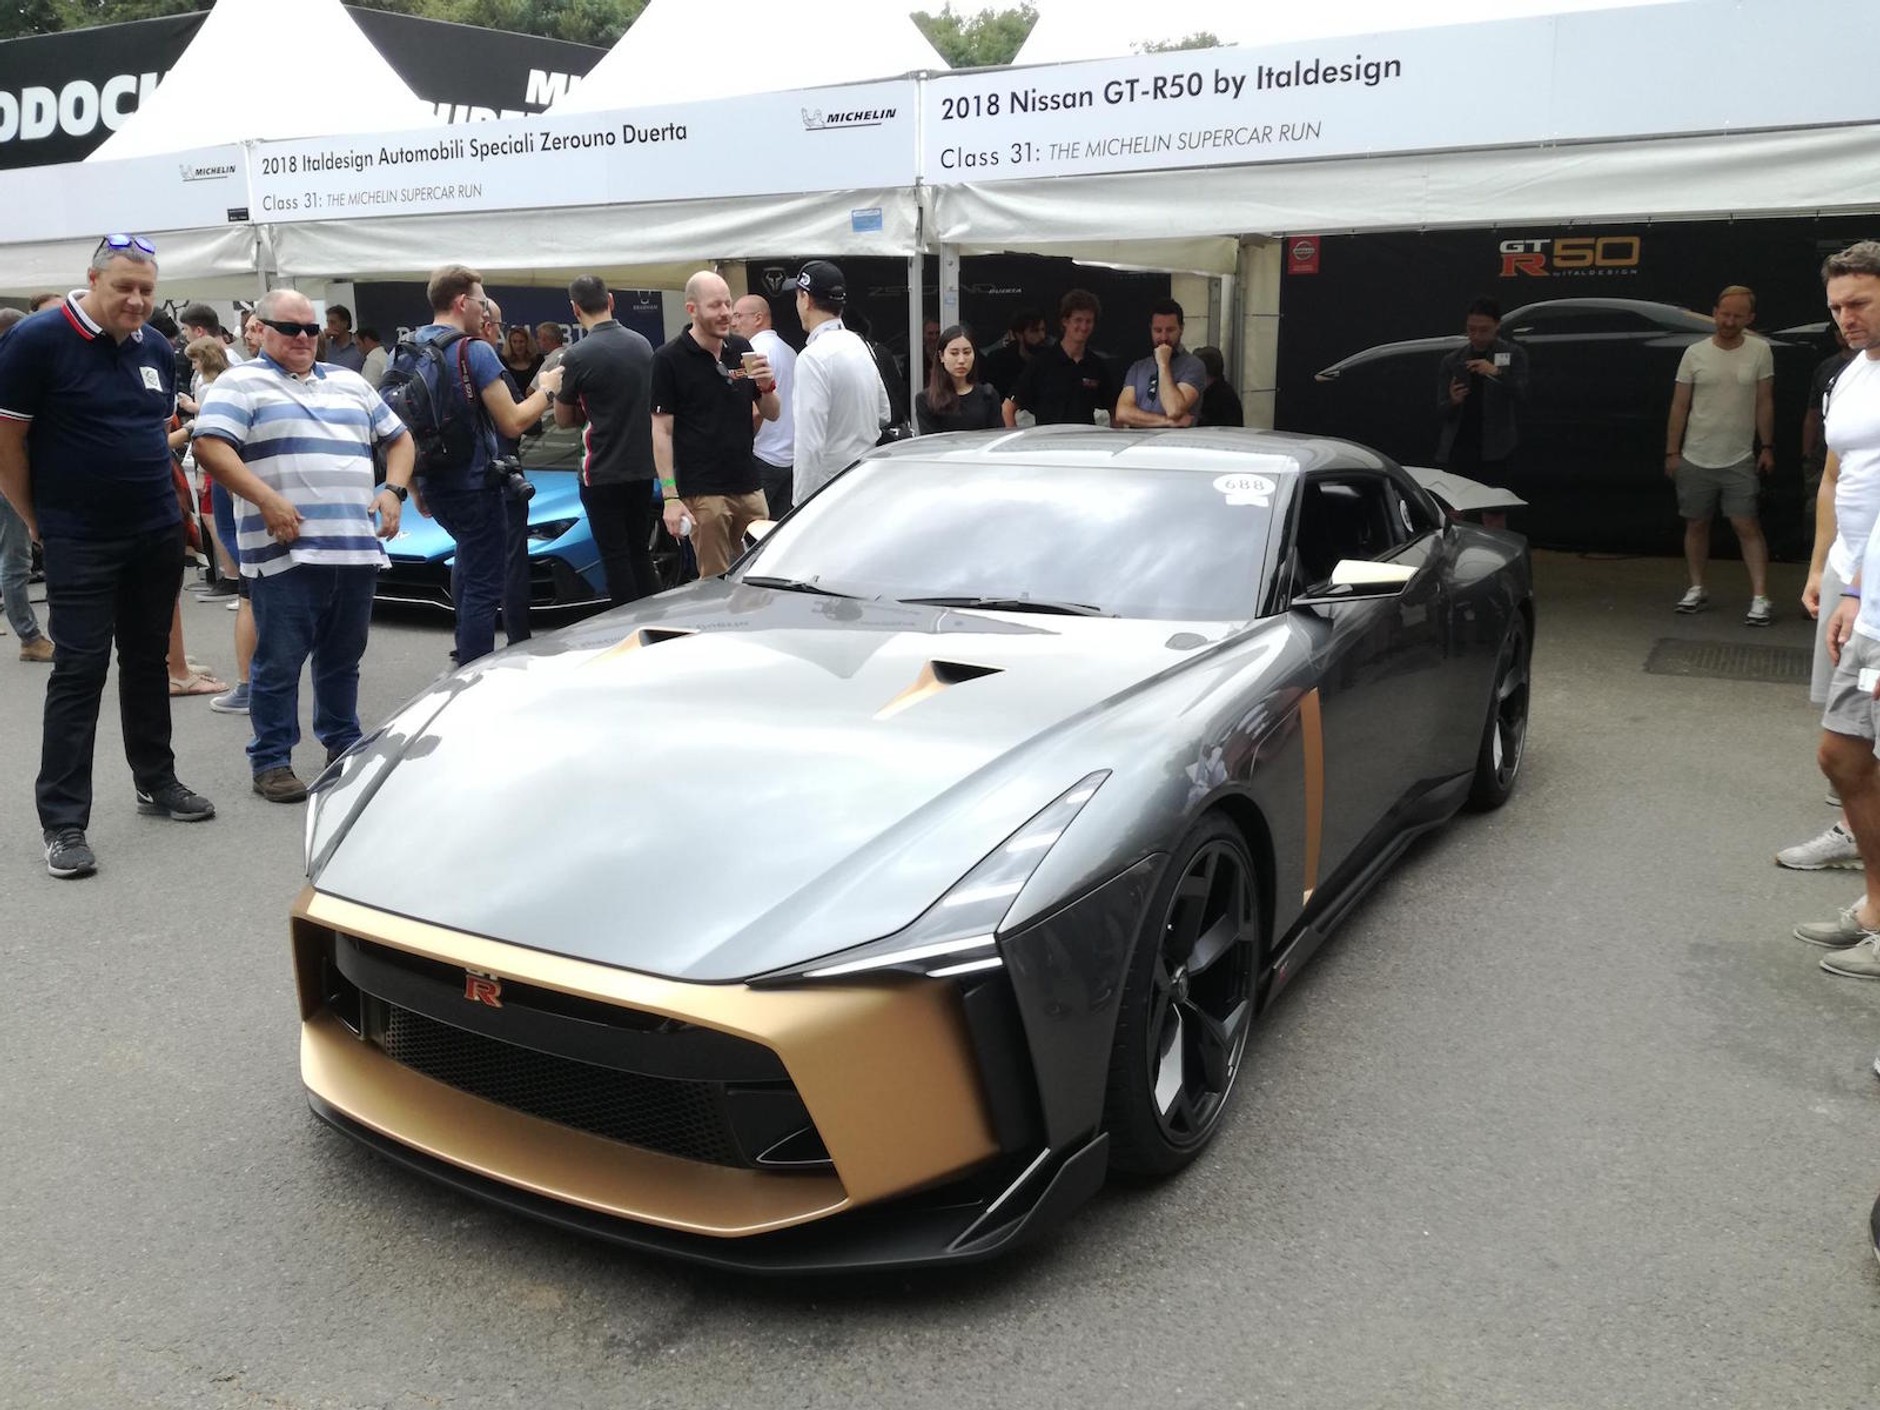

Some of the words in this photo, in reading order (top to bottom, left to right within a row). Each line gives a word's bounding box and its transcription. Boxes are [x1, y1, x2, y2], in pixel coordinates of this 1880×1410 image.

[941, 93, 1000, 121] 2018
[1010, 88, 1093, 114] Nissan
[1103, 72, 1203, 104] GT-R50
[1213, 69, 1246, 99] by
[1256, 54, 1402, 90] Italdesign
[826, 108, 897, 123] MICHELIN
[262, 155, 298, 175] 2018
[302, 150, 374, 172] Italdesign
[378, 139, 465, 166] Automobili
[469, 132, 534, 162] Speciali
[540, 130, 616, 151] Zerouno
[623, 122, 688, 145] Duerta
[941, 147, 999, 169] Class
[1010, 142, 1040, 163] 31:
[1049, 142, 1081, 160] THE
[1085, 134, 1171, 158] MICHELIN
[1177, 125, 1273, 150] SUPERCAR
[1278, 121, 1322, 142] RUN
[195, 165, 236, 176] MICHELIN
[262, 195, 298, 211] Class
[304, 192, 323, 209] 31:
[327, 193, 346, 207] THE
[348, 189, 399, 205] MICHELIN
[400, 185, 455, 203] SUPERCAR
[458, 183, 483, 199] RUN
[1500, 239, 1551, 253] GT
[1553, 236, 1641, 268] 50
[1225, 480, 1265, 490] 688
